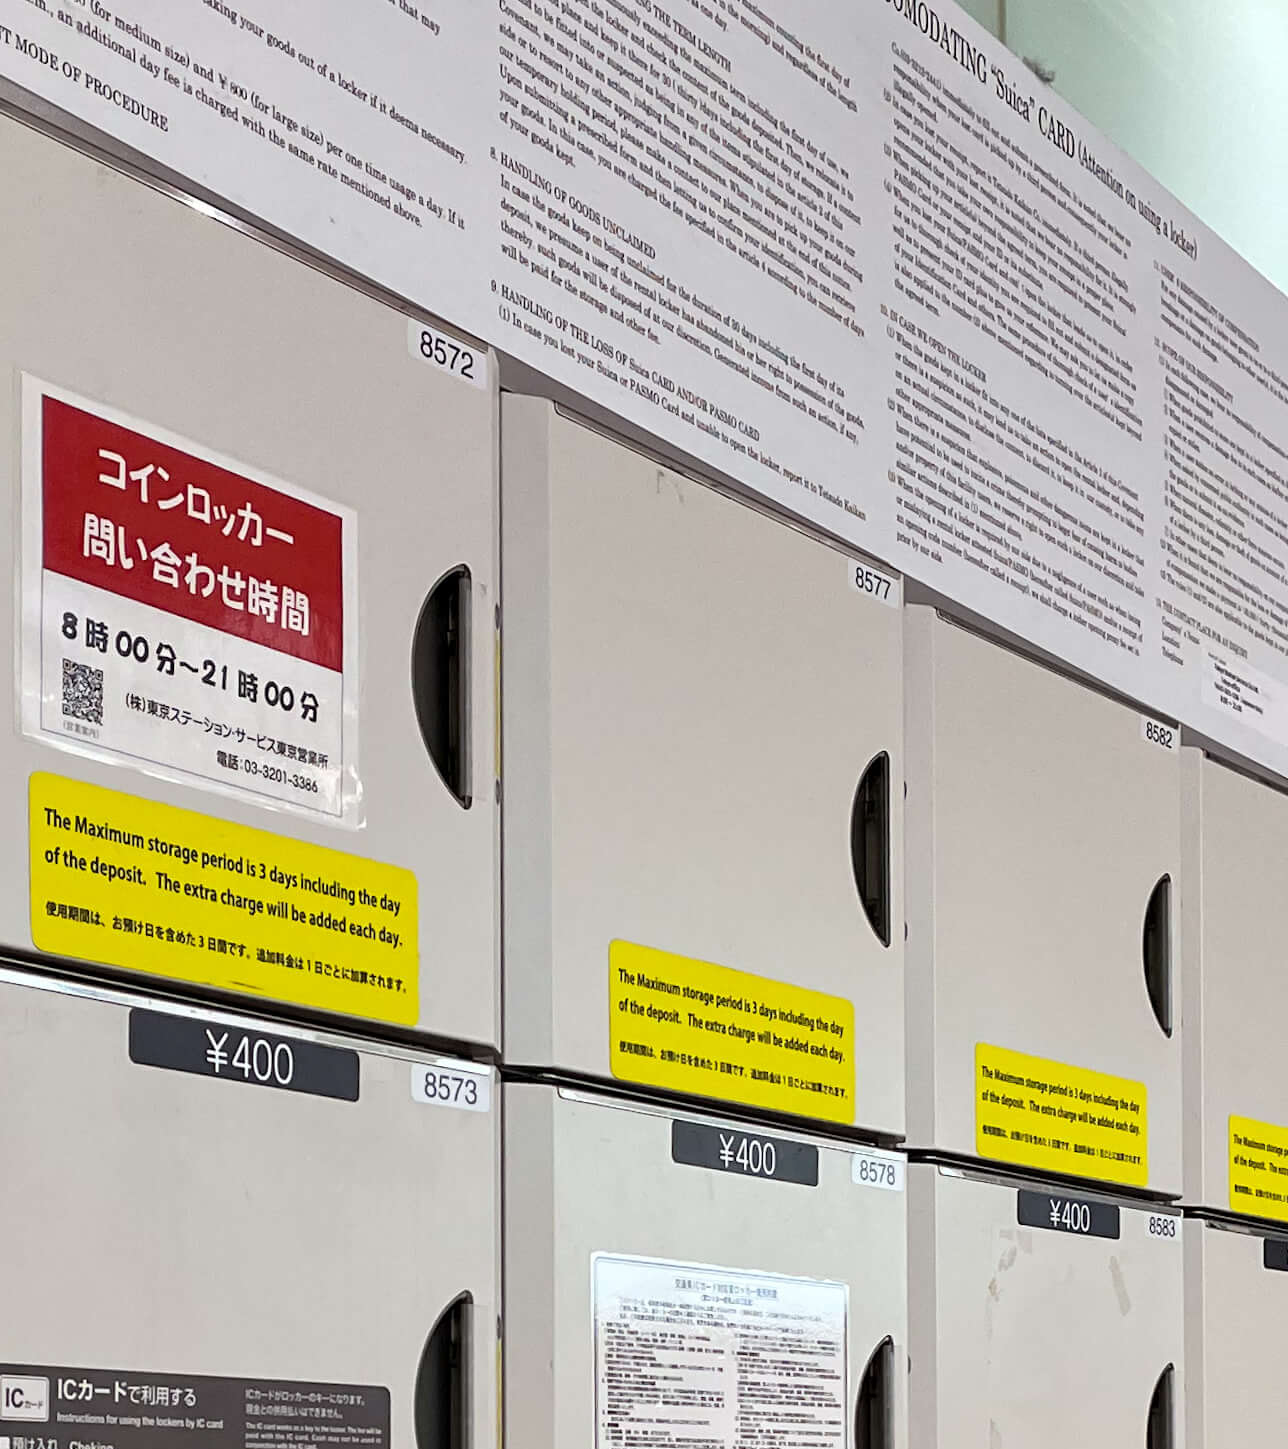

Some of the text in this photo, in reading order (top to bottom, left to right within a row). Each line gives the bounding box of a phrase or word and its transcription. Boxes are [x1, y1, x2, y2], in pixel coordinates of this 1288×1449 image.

[114, 15, 162, 53] medium
[15, 34, 169, 132] MODE OF PROCEDURE
[886, 0, 988, 84] MODATING
[1038, 107, 1075, 158] CARD
[76, 20, 137, 64] additional
[195, 87, 239, 122] charged
[340, 171, 392, 211] mentioned
[500, 152, 656, 259] HANDLING OF GOODS UNCLAIMED
[420, 331, 475, 380] 8572
[98, 448, 294, 546] コインロッカー
[82, 512, 310, 637] 問い合わせ時間
[854, 566, 892, 600] 8577
[1145, 722, 1173, 749] 8582
[44, 808, 401, 917] The Maximum storage period is 3 days including the day
[44, 848, 404, 950] of the deposit. The extra charge will be added each day.
[205, 1028, 294, 1085] ¥400
[423, 1072, 478, 1105] 8573
[719, 1133, 777, 1175] ¥400
[859, 1160, 896, 1185] 8578
[1049, 1199, 1091, 1233] ¥400
[1148, 1217, 1176, 1237] 8583
[57, 1378, 197, 1407] ICカードで利用する
